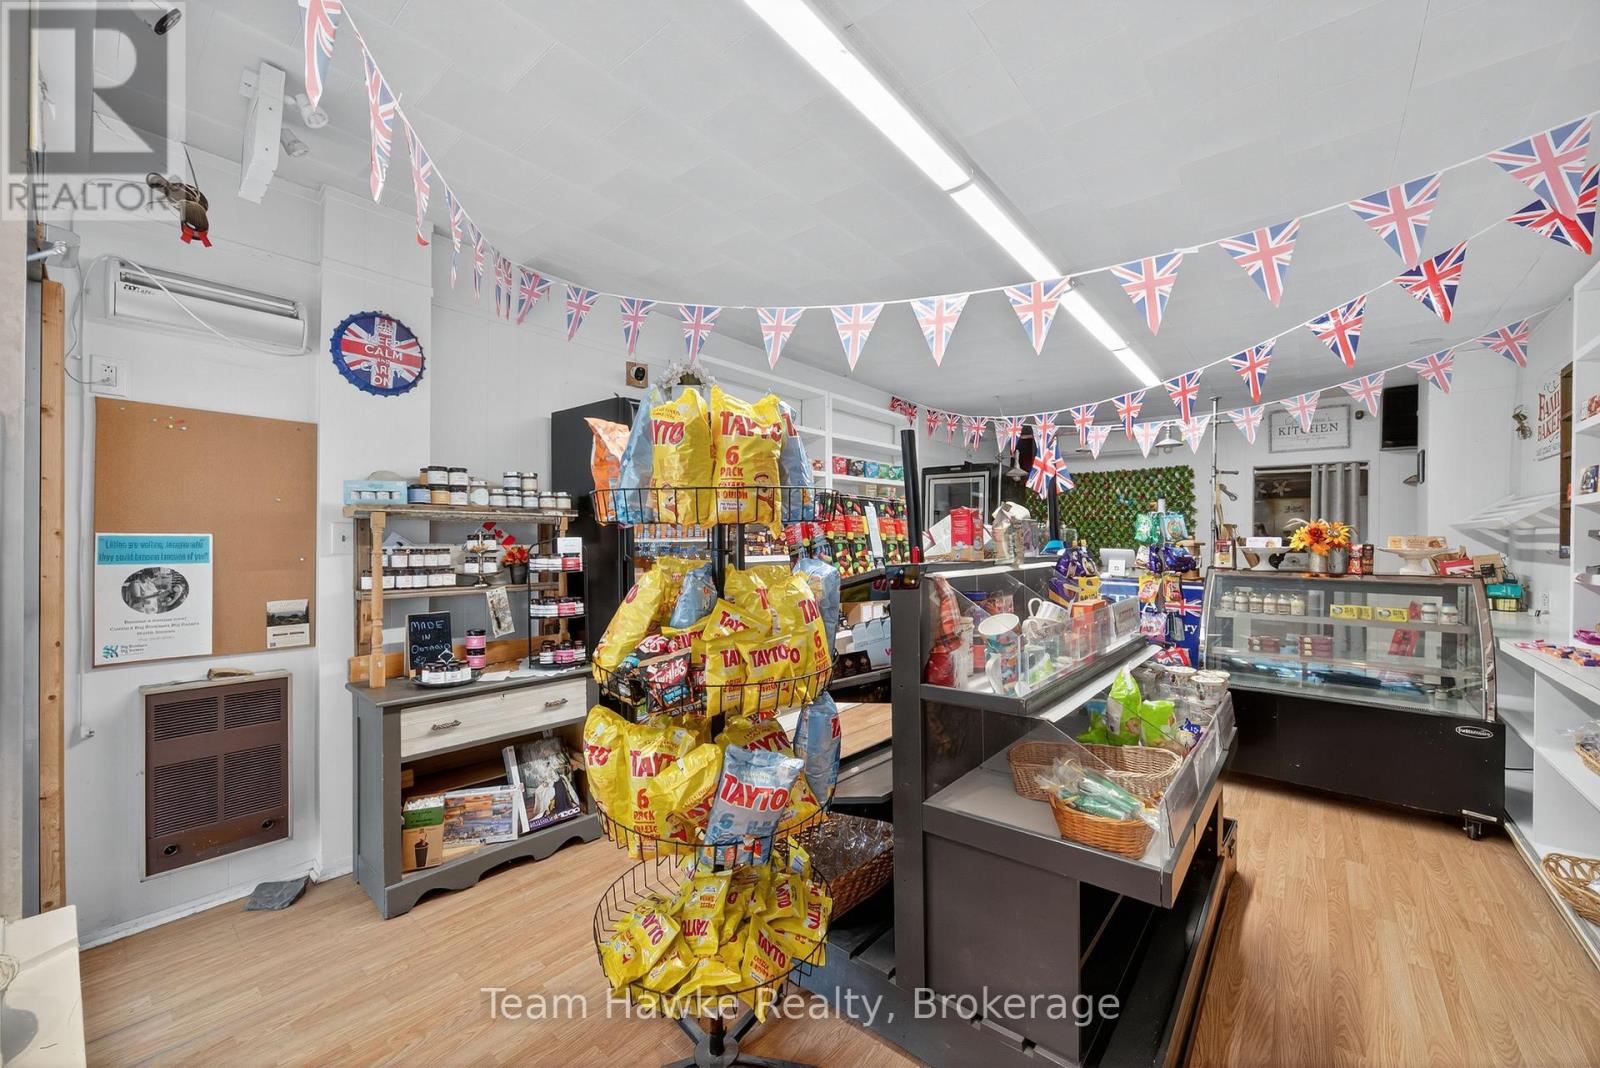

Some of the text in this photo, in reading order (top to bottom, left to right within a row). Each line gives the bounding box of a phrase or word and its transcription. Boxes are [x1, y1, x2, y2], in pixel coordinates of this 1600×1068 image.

[364, 344, 403, 361] CALM
[374, 376, 391, 387] ON
[725, 445, 740, 466] 6
[720, 466, 744, 477] PACK
[410, 620, 445, 632] MADE
[720, 610, 750, 632] TAY
[421, 633, 432, 642] IN
[748, 643, 789, 668] TAYTO
[636, 788, 650, 810] 6
[720, 773, 788, 811] TAYTO
[719, 812, 735, 830] 6
[758, 929, 786, 969] TAYTO
